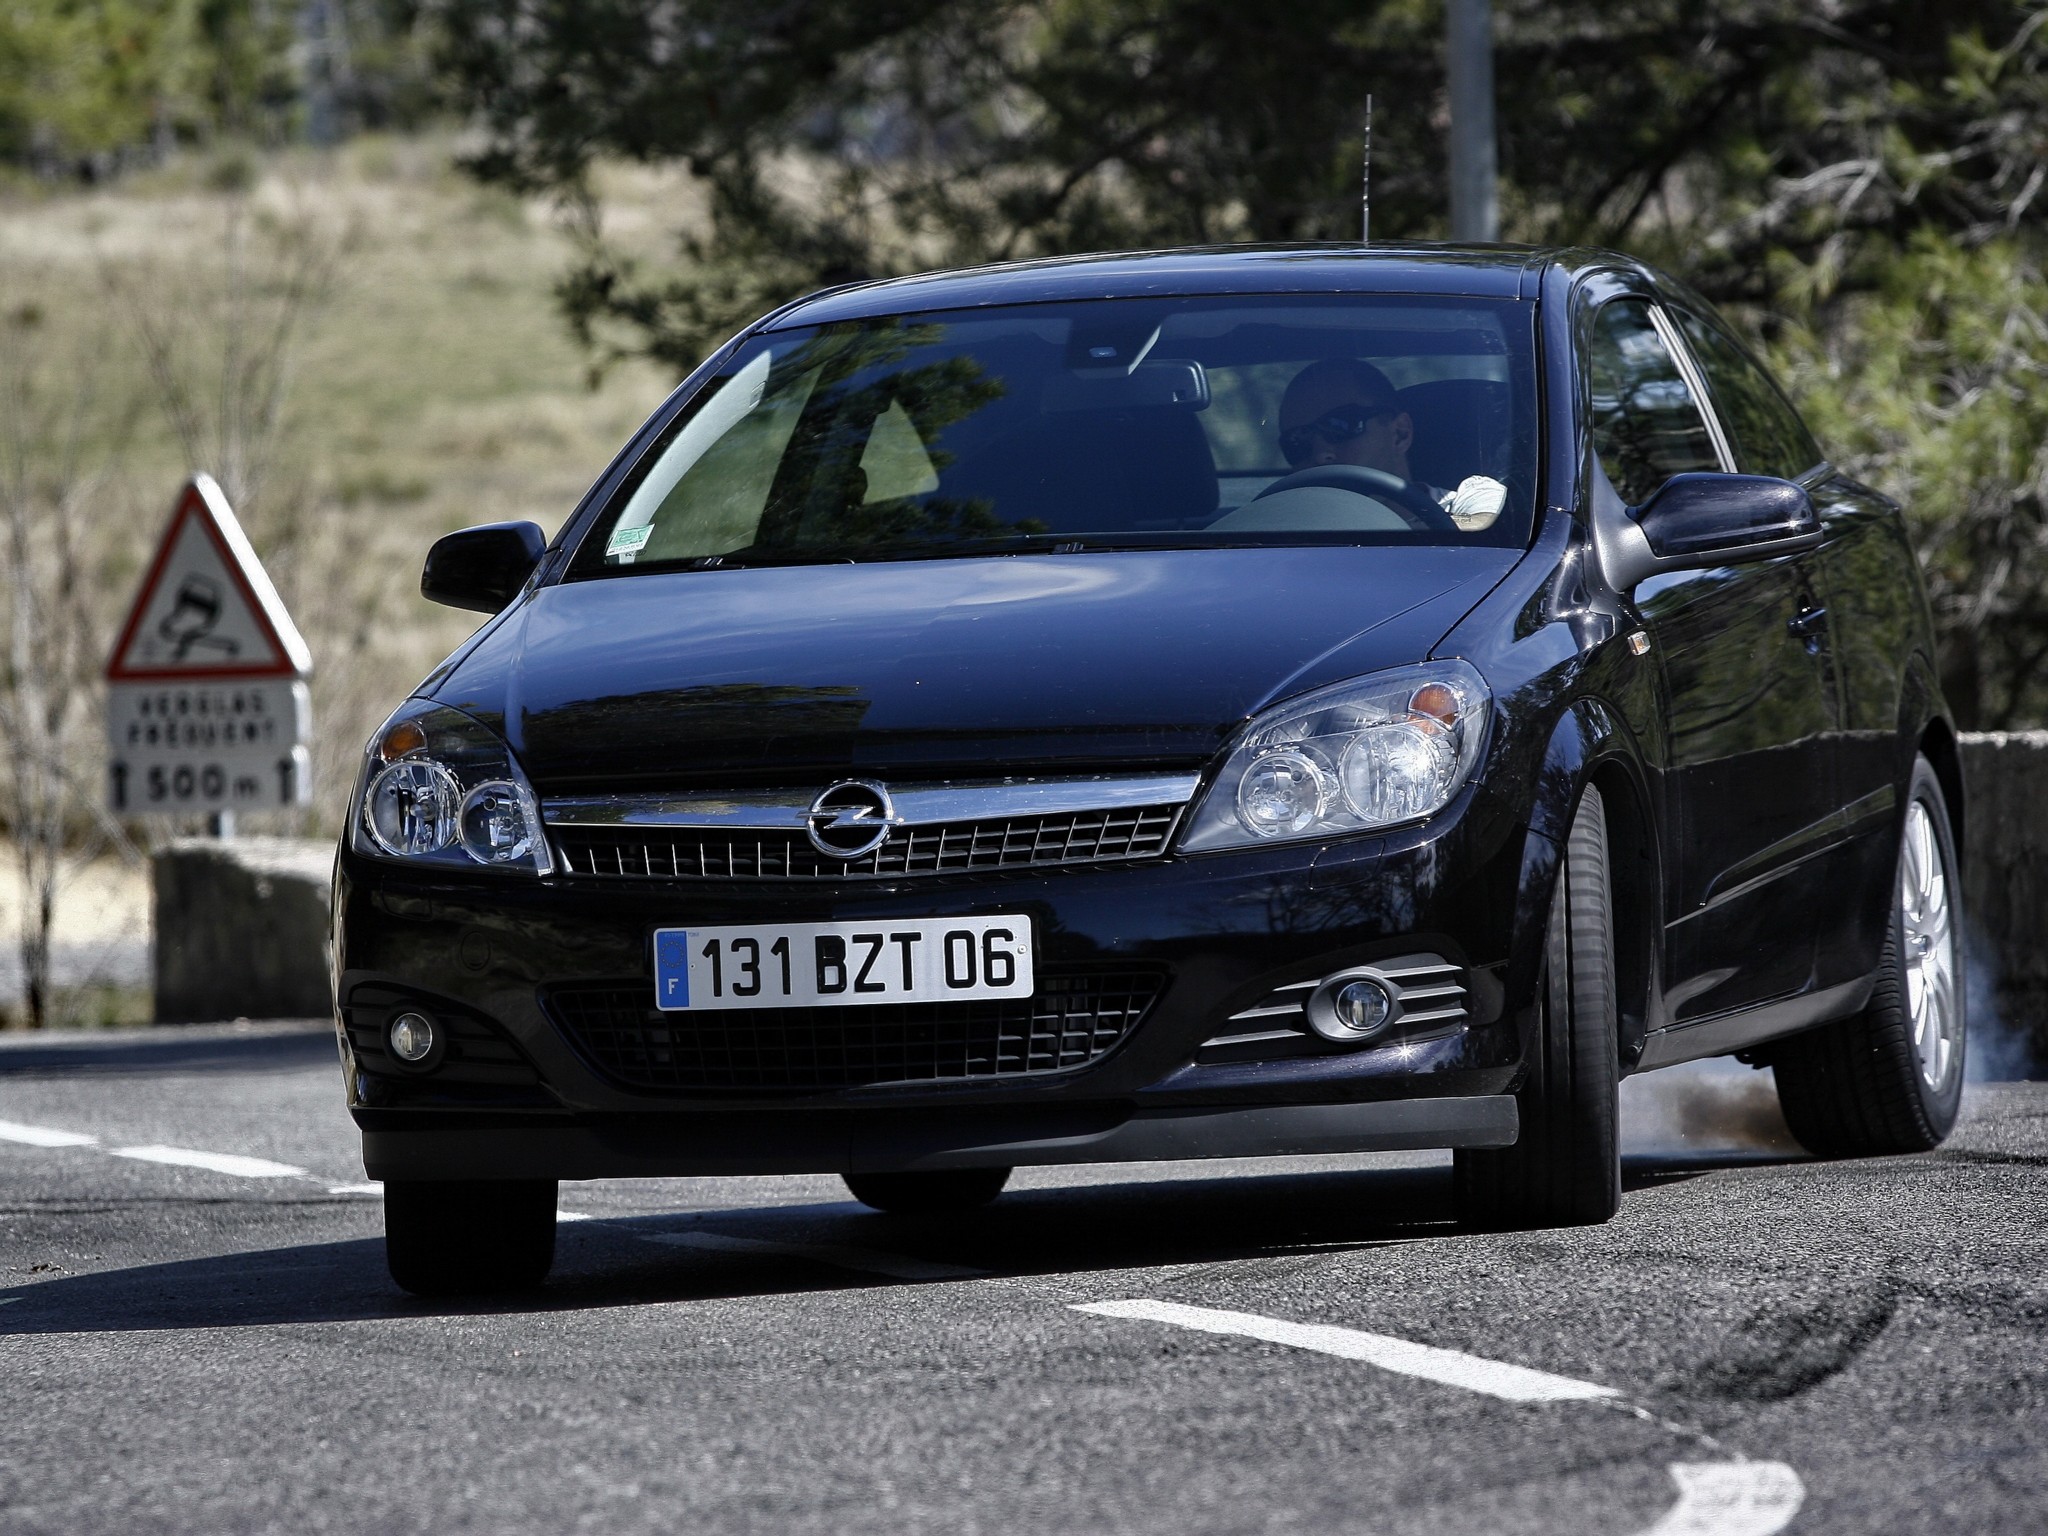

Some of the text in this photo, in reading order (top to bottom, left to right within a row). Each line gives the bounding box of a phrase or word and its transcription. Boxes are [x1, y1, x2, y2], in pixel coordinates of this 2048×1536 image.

[702, 928, 1015, 997] 131 BZT 06
[668, 978, 679, 995] F
